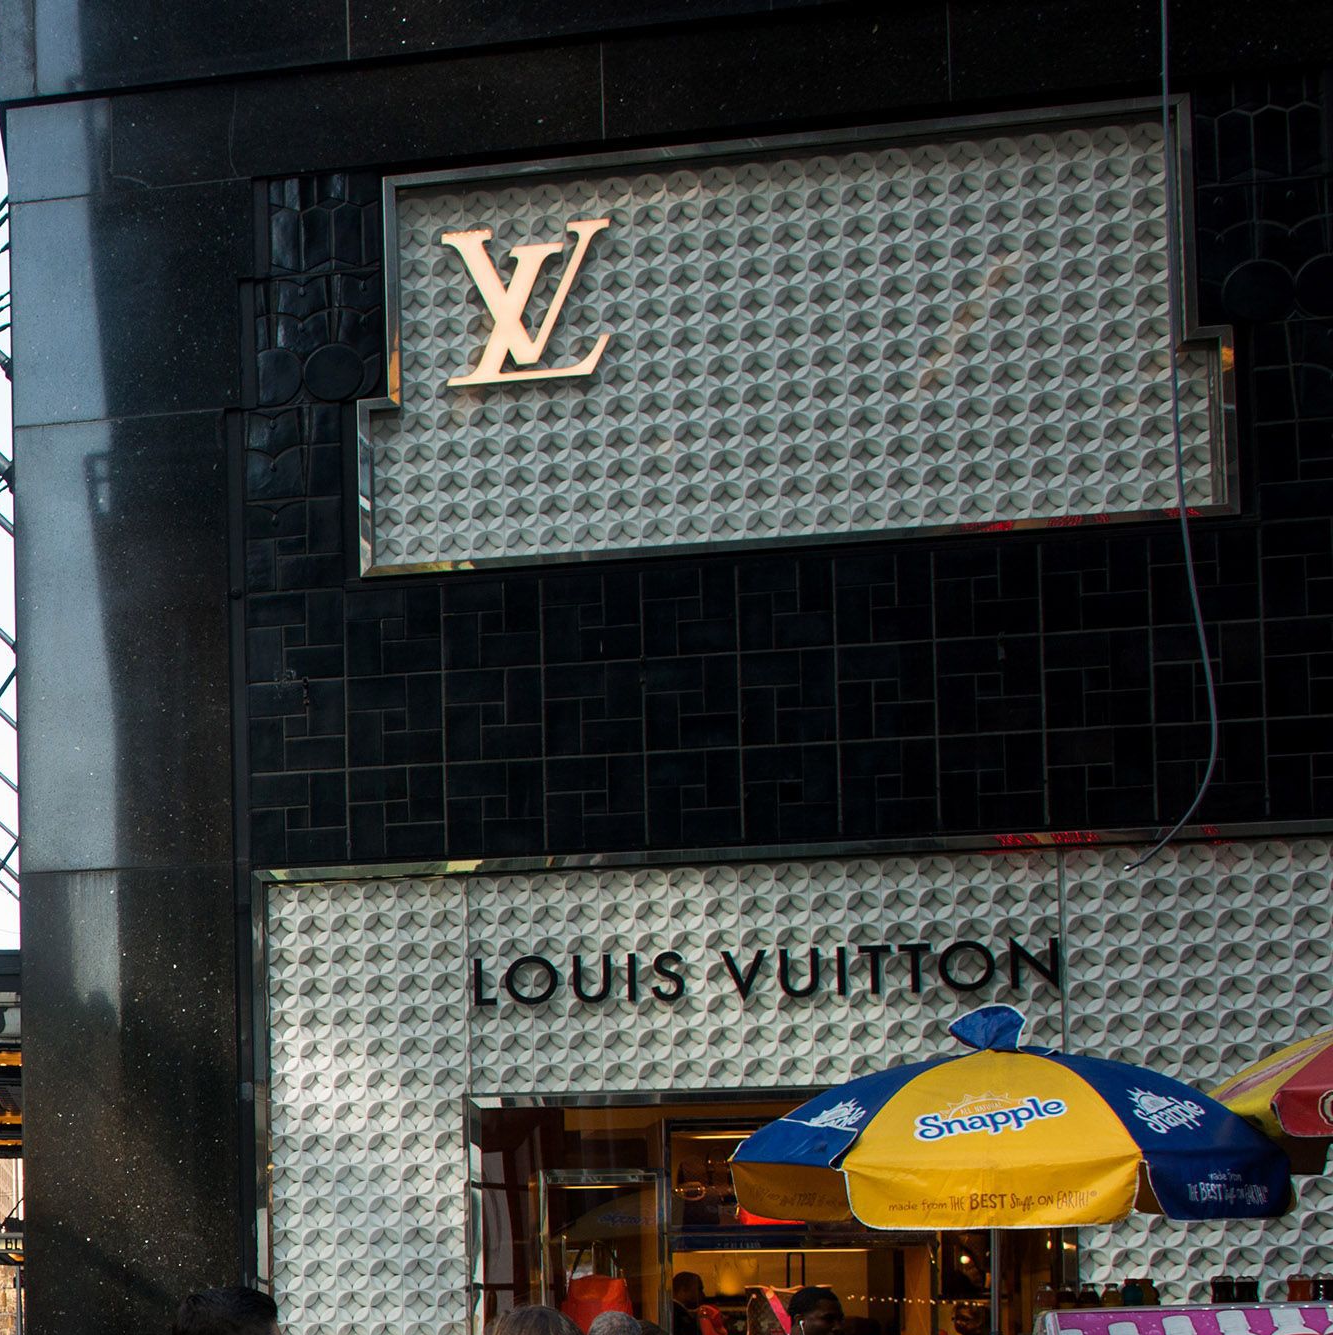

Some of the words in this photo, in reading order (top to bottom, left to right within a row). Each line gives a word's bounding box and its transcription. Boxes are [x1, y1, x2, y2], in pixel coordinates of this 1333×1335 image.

[473, 950, 686, 1007] LOUIS
[721, 937, 1060, 1002] VUITTON
[916, 1097, 1065, 1140] Snapple
[888, 1200, 917, 1211] made
[921, 1199, 947, 1211] from
[949, 1196, 965, 1211] THE
[970, 1193, 1008, 1210] BEST
[1037, 1195, 1054, 1206] ON
[1199, 1182, 1224, 1202] BEST
